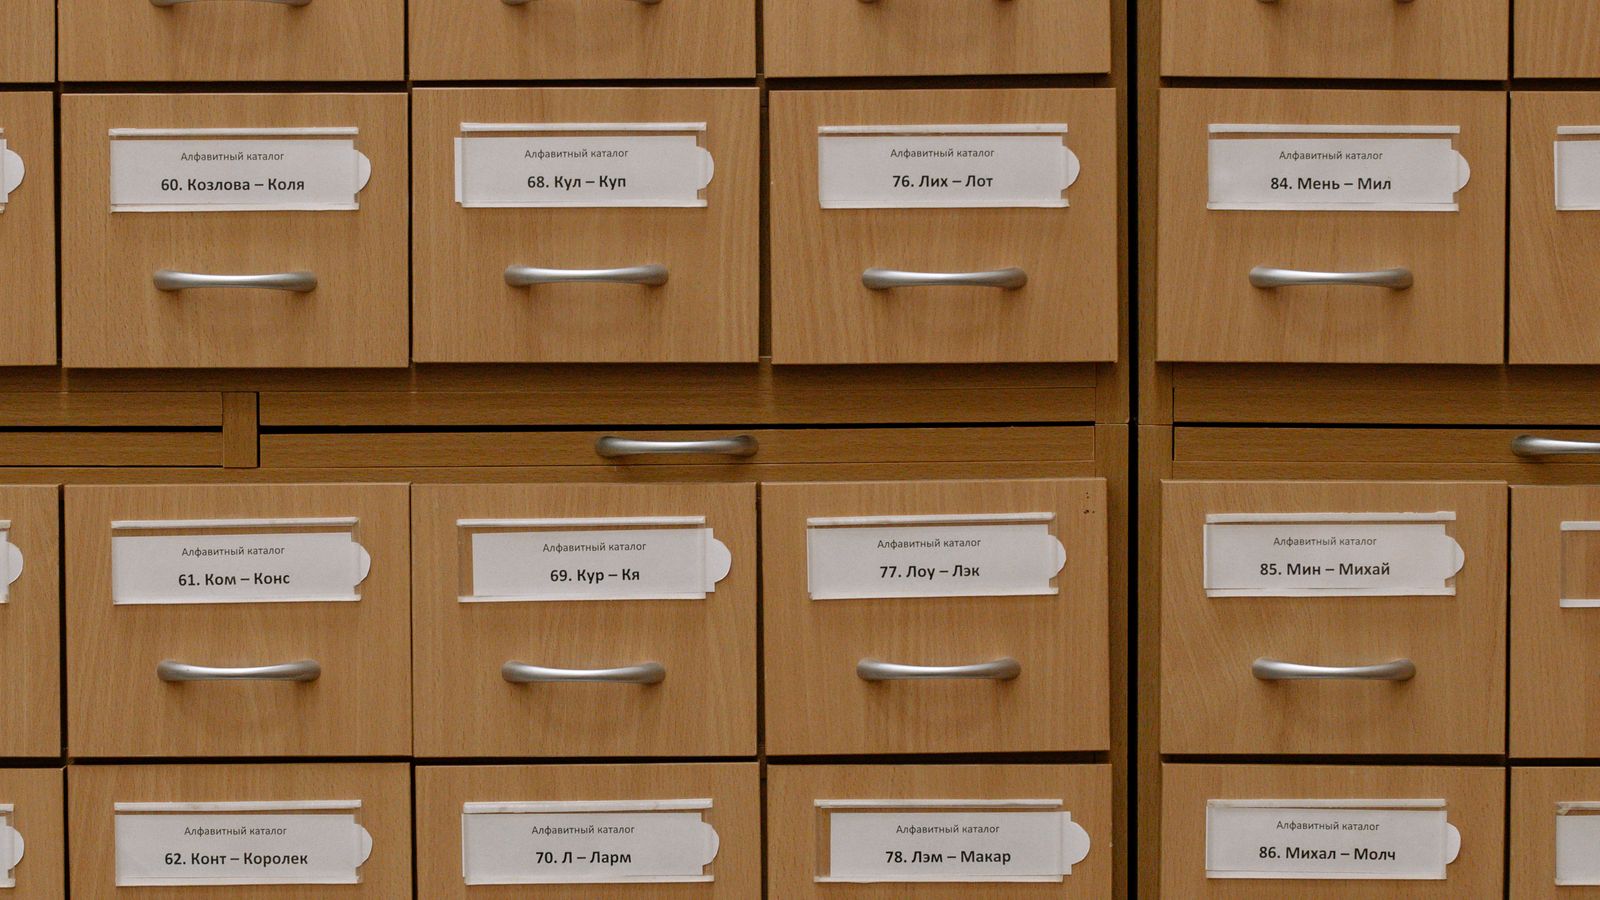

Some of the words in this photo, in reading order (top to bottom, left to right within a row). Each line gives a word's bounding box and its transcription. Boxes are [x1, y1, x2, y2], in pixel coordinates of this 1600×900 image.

[180, 151, 244, 163] Алфавитный
[246, 153, 285, 161] каталог
[524, 148, 588, 161] Алфавитный
[590, 150, 629, 158] каталог
[889, 147, 954, 160] Алфавитный
[956, 149, 995, 158] каталог
[1278, 150, 1343, 162] Алфавитный
[1345, 152, 1384, 160] каталог
[160, 178, 183, 192] 60.
[187, 178, 251, 192] Козлова
[267, 177, 305, 191] Коля
[527, 175, 550, 189] 68.
[554, 175, 582, 192] Кул
[599, 174, 627, 191] Куп
[892, 174, 915, 188] 76.
[918, 174, 949, 188] Лих
[964, 174, 994, 188] Лот
[1270, 176, 1293, 190] 84.
[1297, 177, 1341, 191] Мень
[1357, 176, 1392, 191] Мил
[542, 541, 606, 554] Алфавитный
[608, 543, 647, 552] каталог
[876, 538, 941, 551] Алфавитный
[943, 539, 982, 548] каталог
[1272, 536, 1337, 548] Алфавитный
[1339, 538, 1377, 546] каталог
[181, 546, 245, 559] Алфавитный
[247, 547, 286, 556] каталог
[879, 565, 902, 579] 77.
[905, 565, 936, 581] Лоу
[951, 564, 980, 578] Лэк
[1259, 562, 1282, 576] 85.
[1286, 562, 1321, 576] Мин
[1338, 561, 1390, 576] Михай
[178, 573, 201, 587] 61.
[204, 573, 237, 587] Ком
[253, 572, 291, 585] Конс
[550, 569, 573, 583] 69.
[576, 568, 605, 585] Кур
[621, 568, 640, 581] Кя
[183, 825, 247, 838] Алфавитный
[249, 828, 288, 836] каталог
[531, 824, 595, 837] Алфавитный
[597, 826, 635, 834] каталог
[895, 824, 960, 836] Алфавитный
[961, 826, 1000, 834] каталог
[1276, 820, 1340, 832] Алфавитный
[1341, 823, 1380, 831] каталог
[164, 852, 187, 866] 62.
[190, 852, 227, 866] Конт
[243, 851, 309, 868] Королек
[535, 851, 558, 865] 70.
[561, 851, 573, 864] Л
[589, 850, 632, 867] Ларм
[885, 850, 908, 864] 78.
[911, 850, 944, 864] Лэм
[960, 850, 1012, 866] Макар
[1258, 846, 1281, 859] 86.
[1285, 846, 1337, 860] Михал
[1353, 847, 1396, 861] Молч
